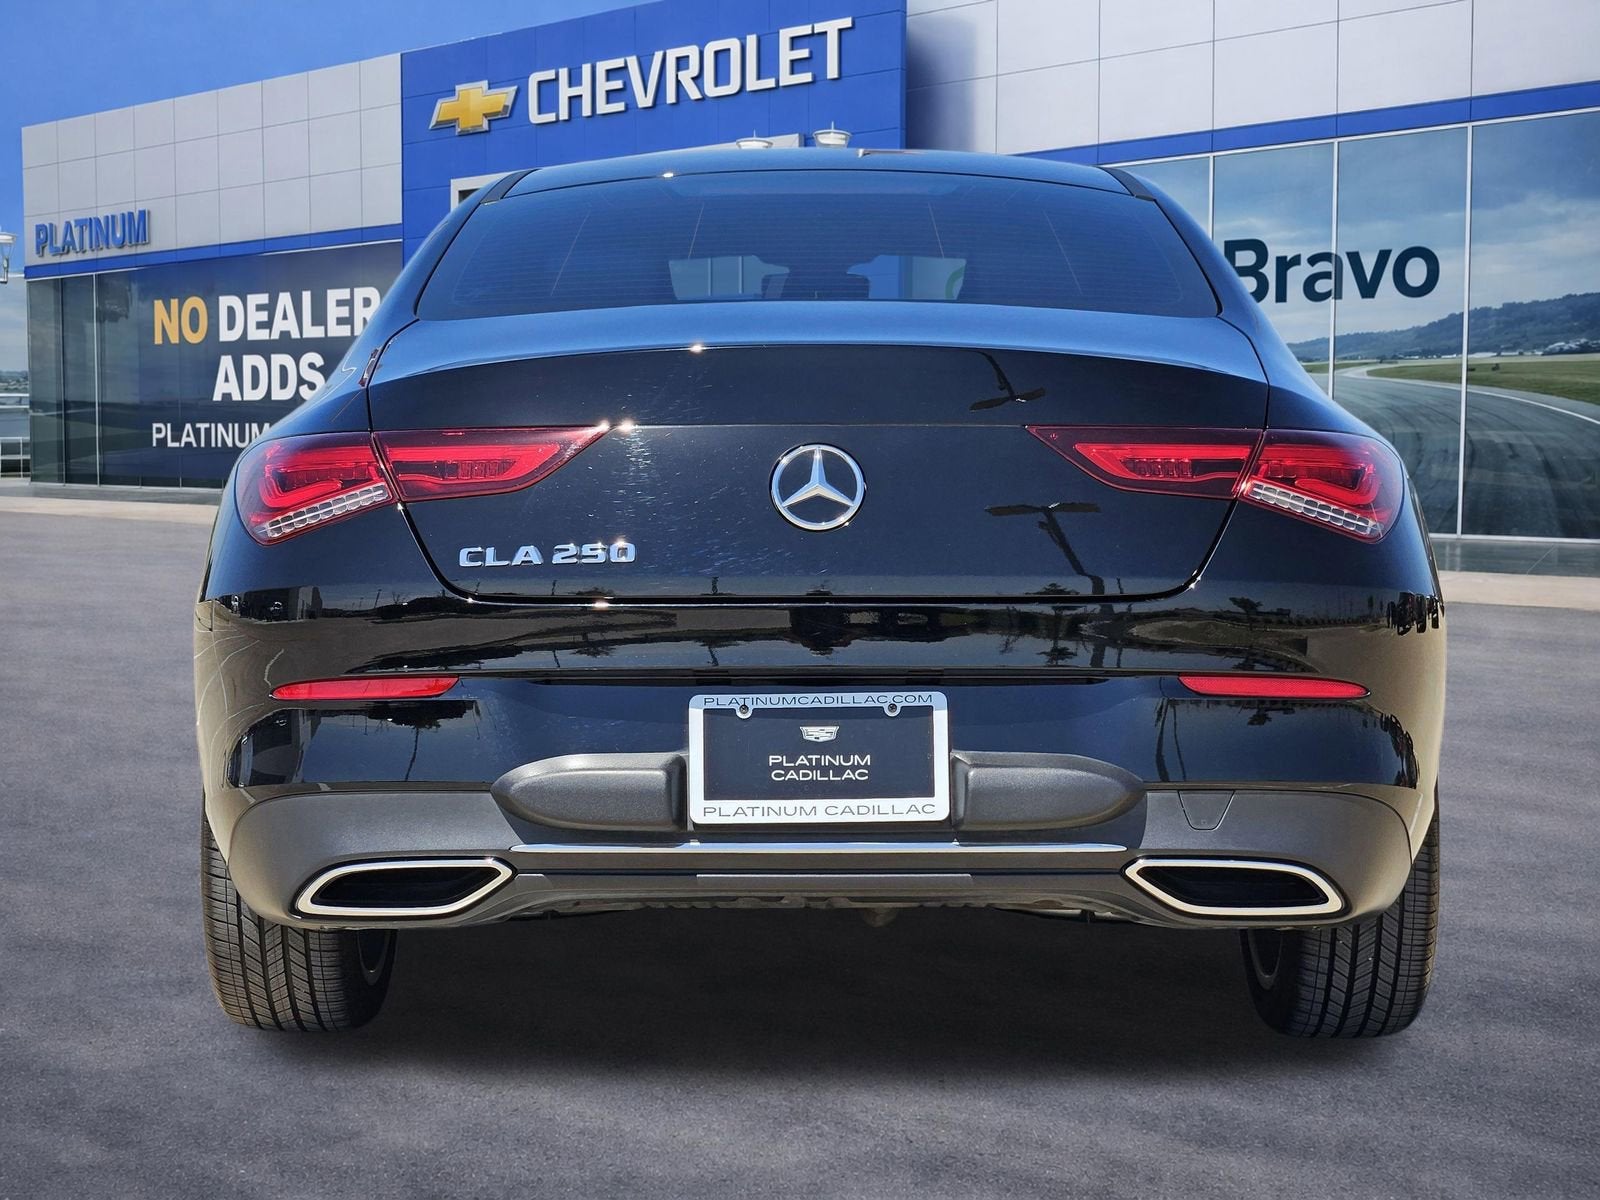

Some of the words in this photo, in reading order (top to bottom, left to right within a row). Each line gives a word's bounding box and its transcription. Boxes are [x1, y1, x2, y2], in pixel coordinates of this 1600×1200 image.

[528, 16, 853, 124] CHEVROLET
[35, 209, 149, 257] PLATINUM
[1223, 238, 1440, 303] Bravo
[154, 295, 208, 345] NO
[218, 286, 380, 342] DEALER
[212, 352, 325, 402] ADDS
[459, 545, 544, 567] CLA
[551, 541, 636, 565] 250
[703, 694, 932, 706] PLATINUMCADILLAC.COM
[769, 754, 871, 767] PLATINUM
[771, 769, 869, 781] CADILLAC
[703, 805, 817, 817] PLATINUM
[824, 803, 936, 815] CADILLAC
